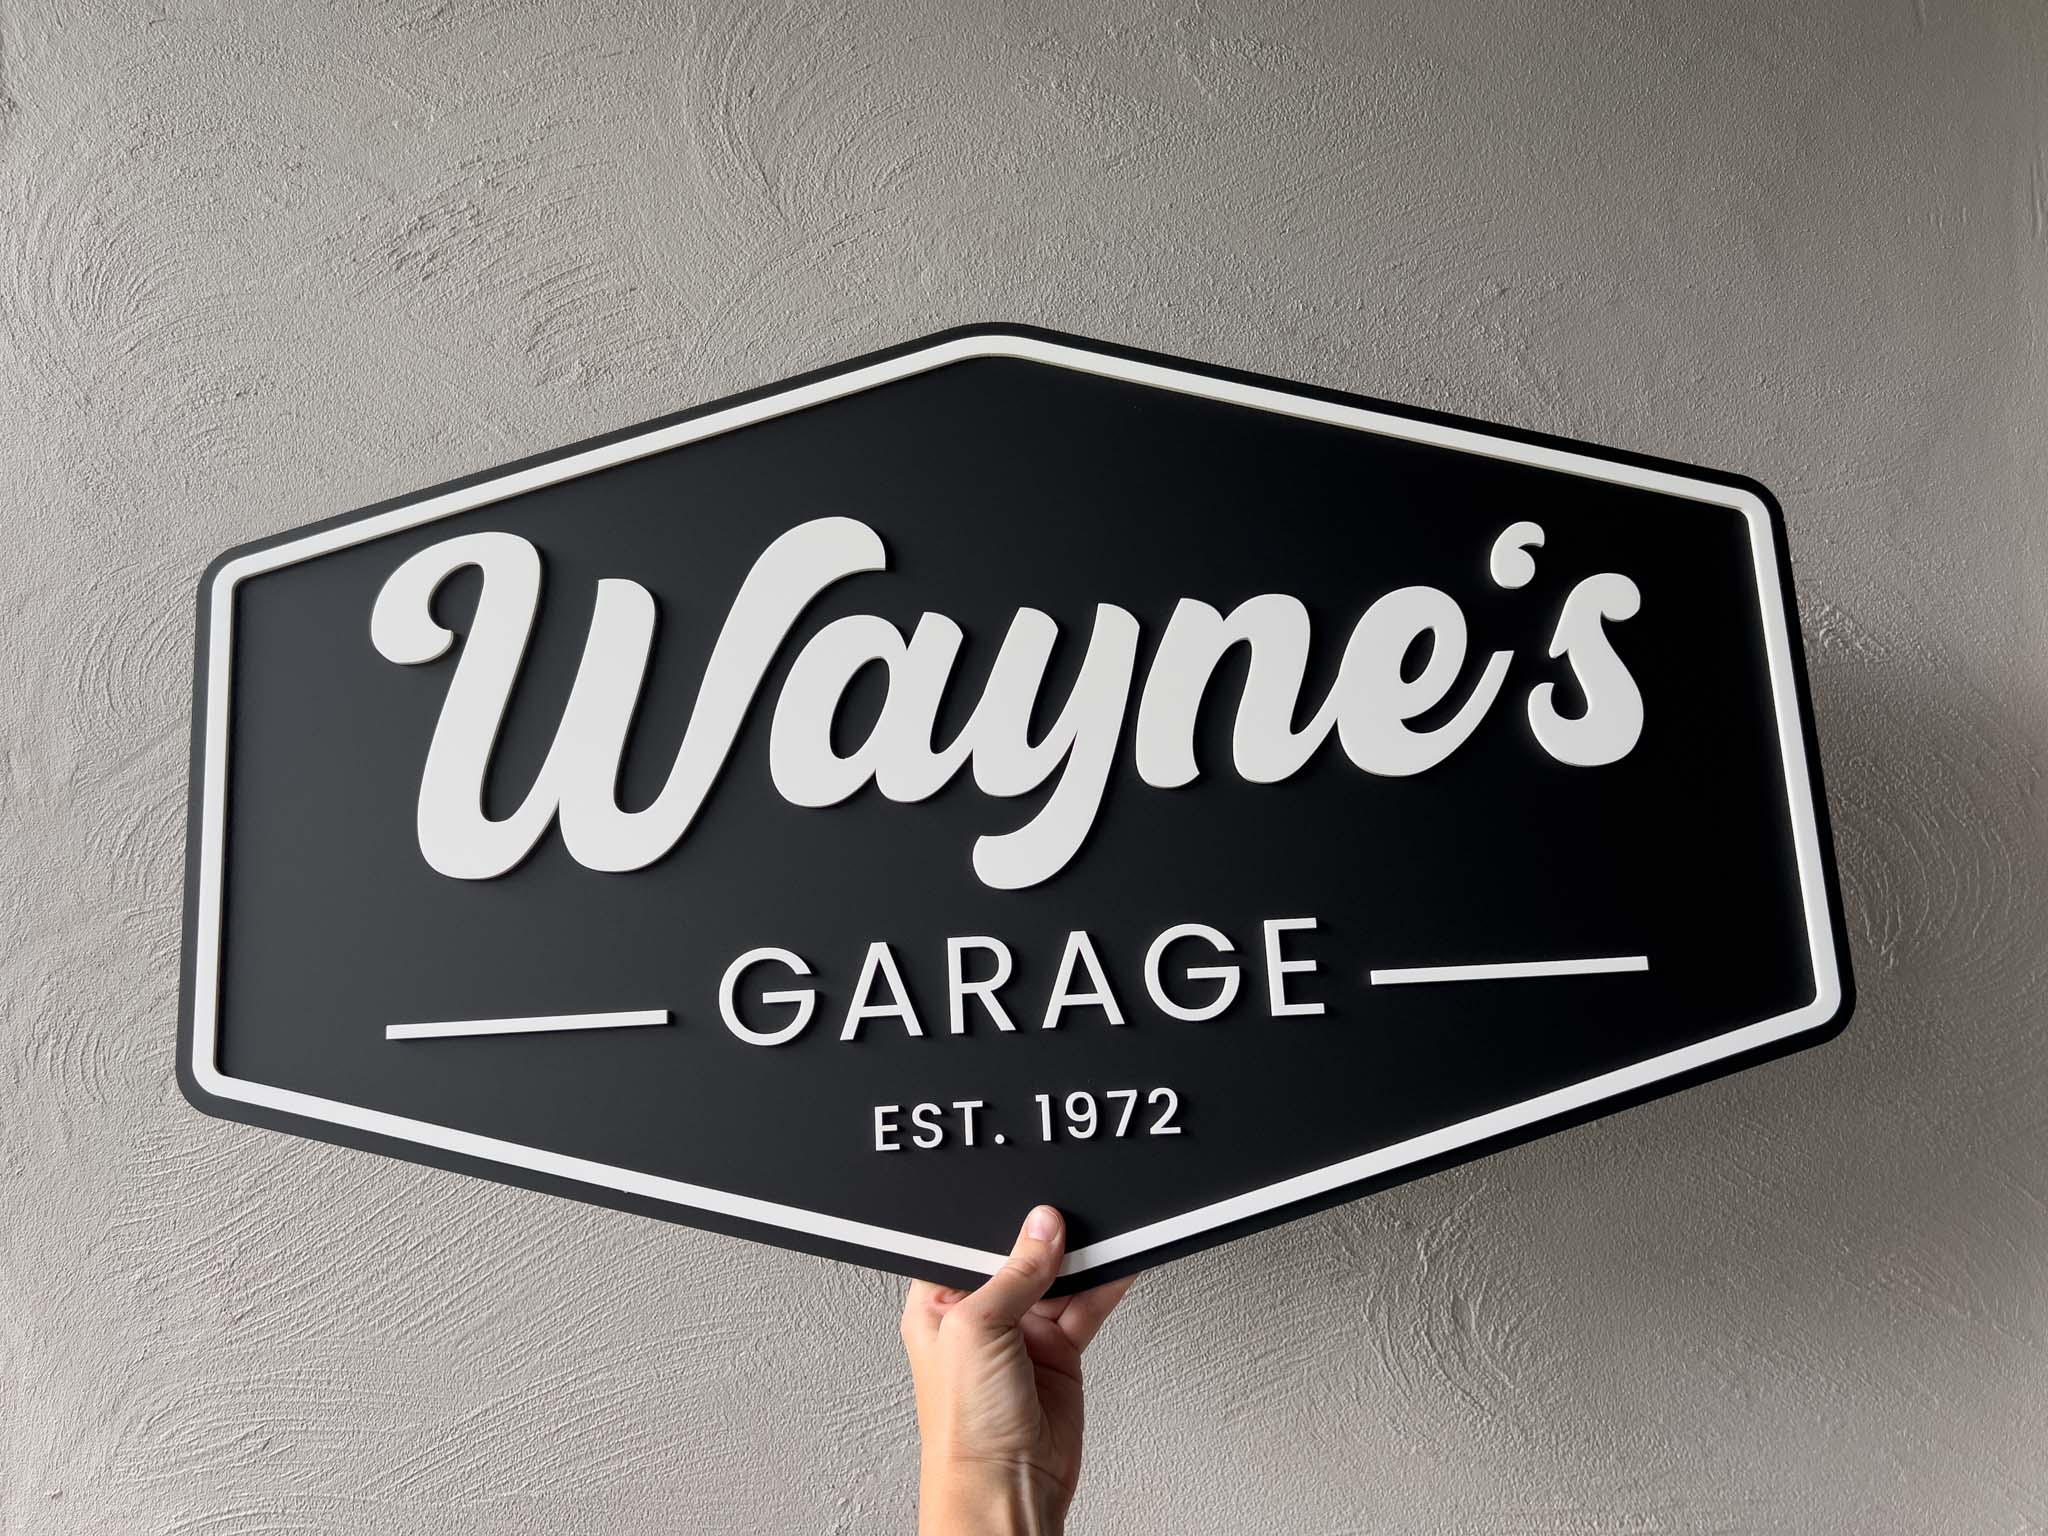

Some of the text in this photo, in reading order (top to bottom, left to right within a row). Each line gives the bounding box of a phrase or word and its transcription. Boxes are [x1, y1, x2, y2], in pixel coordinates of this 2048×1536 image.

[370, 515, 1645, 890] Wayne's
[718, 917, 1326, 1047] GARAGE
[874, 1086, 1182, 1153] EST. 1972
